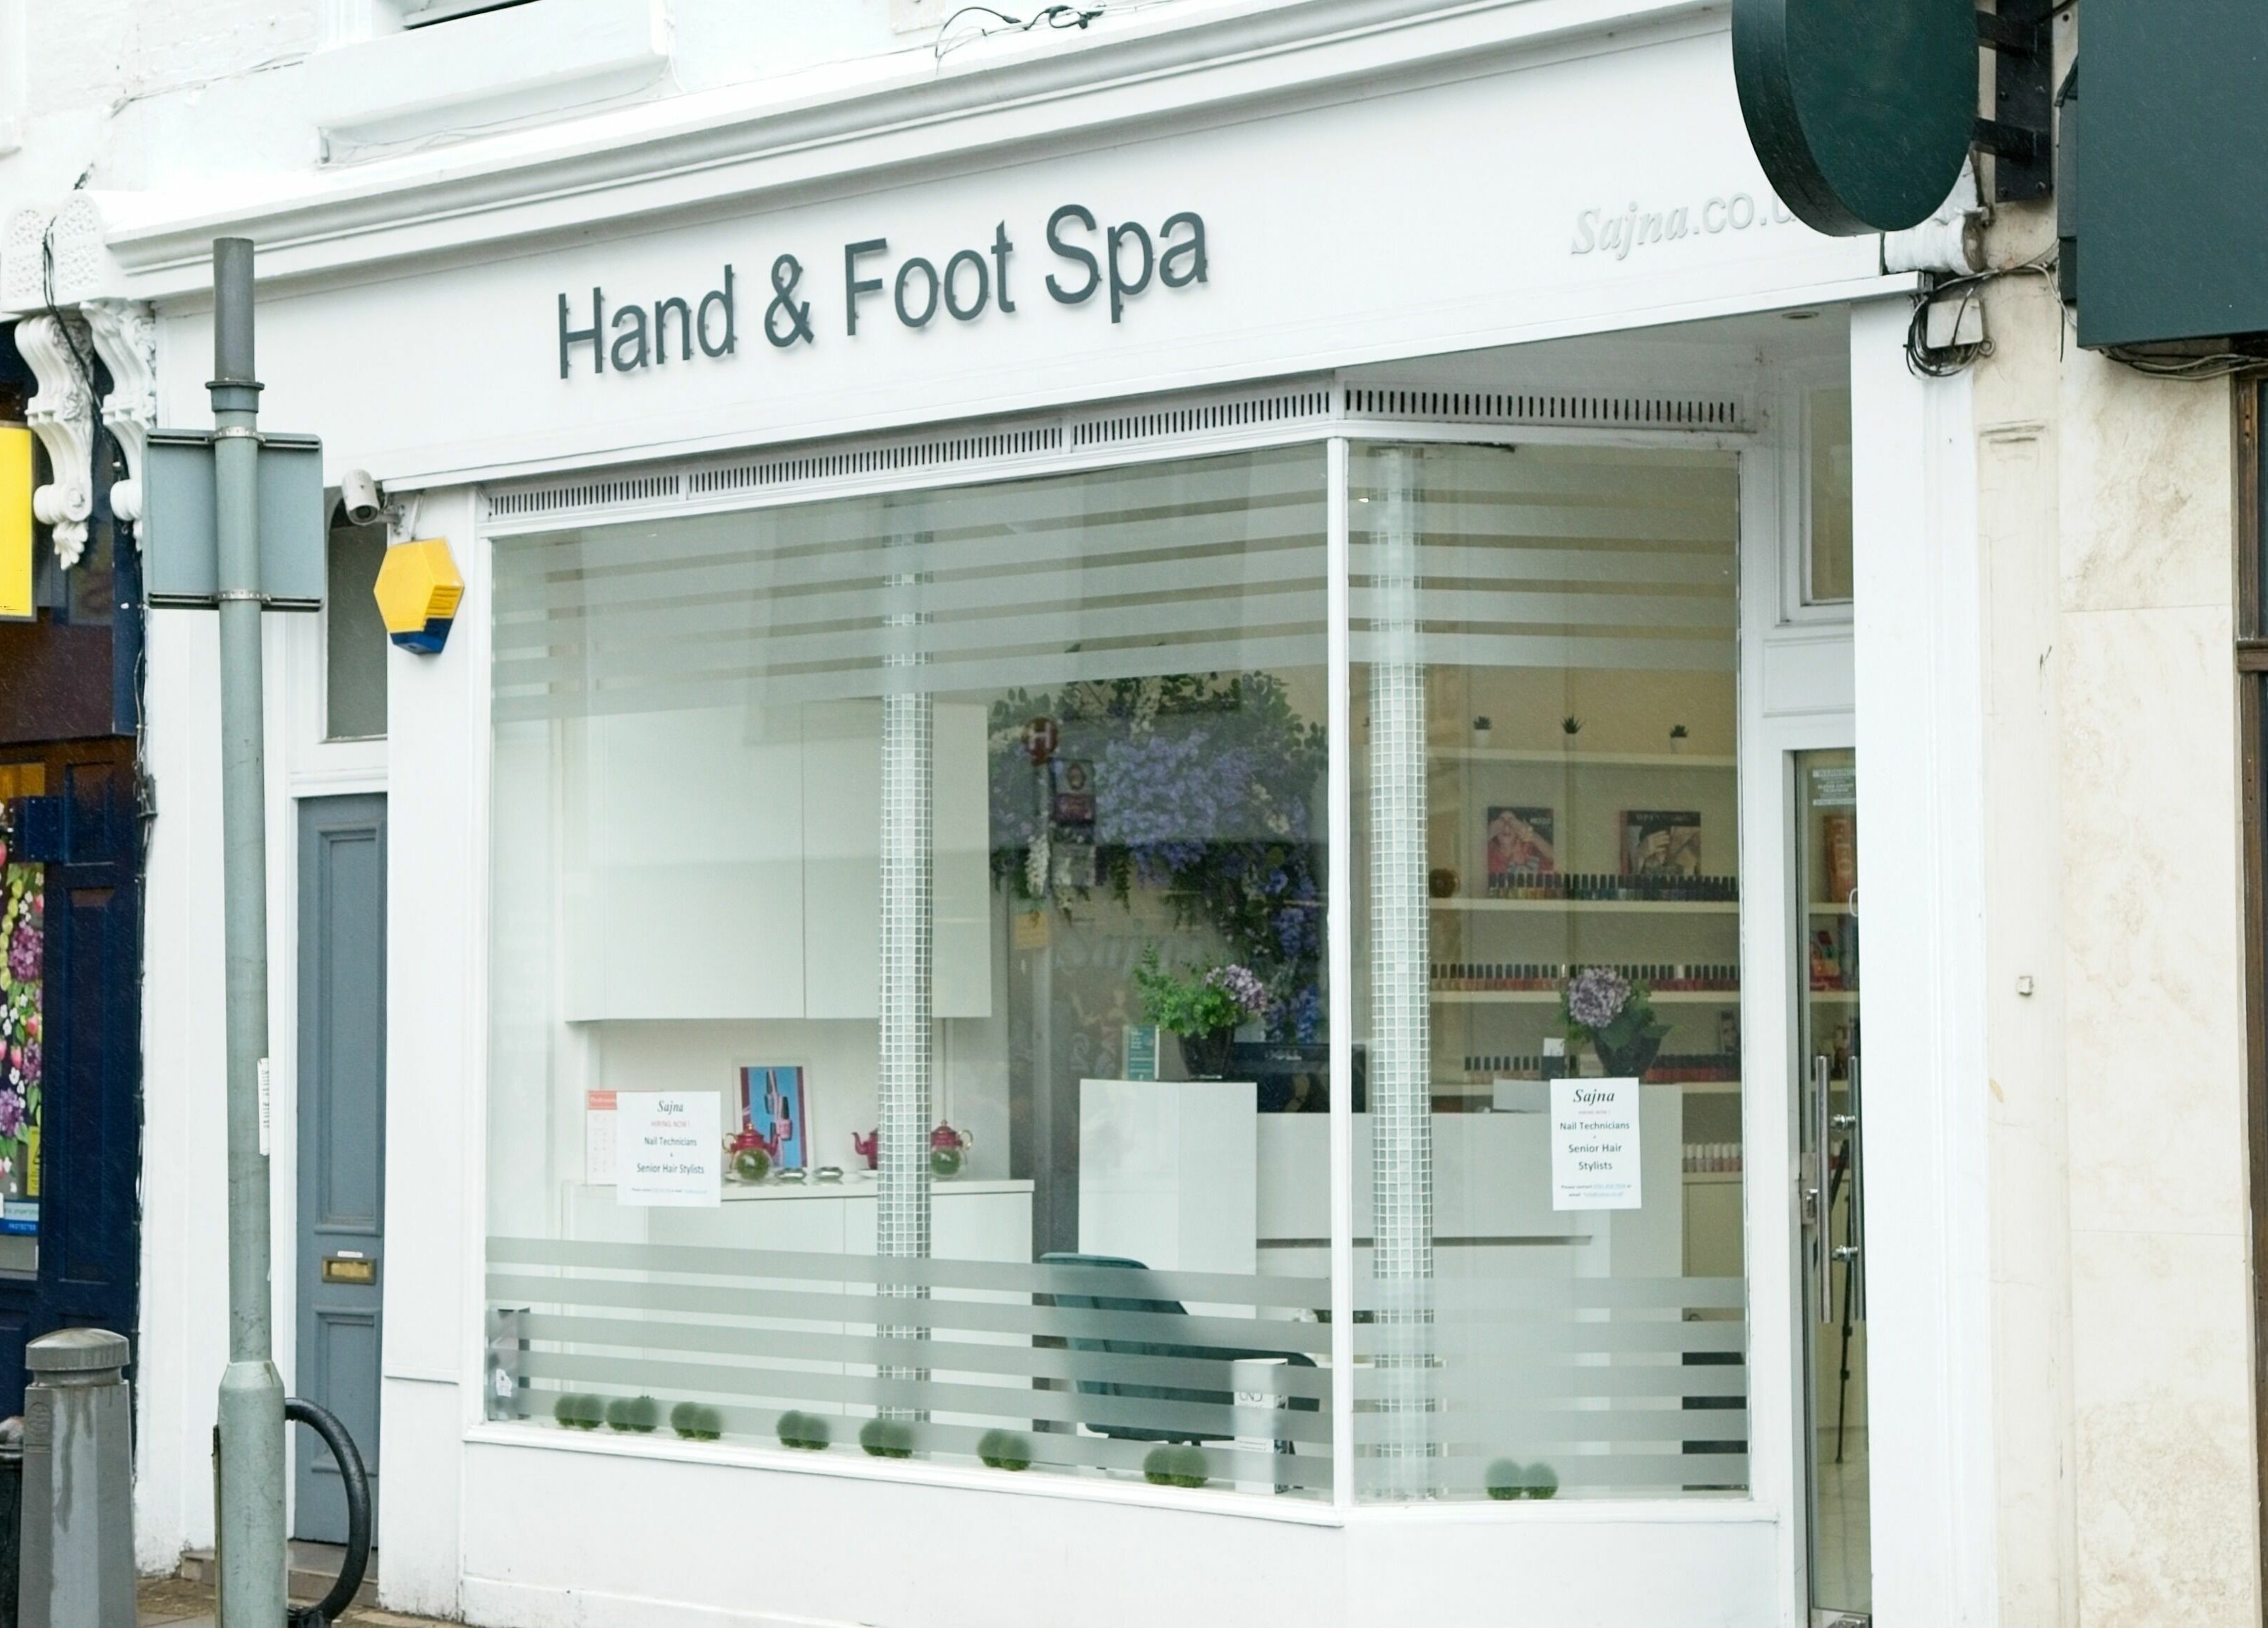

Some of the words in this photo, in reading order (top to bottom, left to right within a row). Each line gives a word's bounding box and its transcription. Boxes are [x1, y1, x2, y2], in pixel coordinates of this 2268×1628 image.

[558, 264, 736, 380] Hand
[764, 253, 815, 348] &
[844, 220, 1016, 337] Foot
[1044, 203, 1209, 324] Spa
[1573, 1089, 1615, 1105] Sajna
[657, 1100, 683, 1115] Sajna
[1579, 1121, 1630, 1130] Technicians
[644, 1137, 657, 1146] Nail
[659, 1137, 697, 1147] Technicians
[1568, 1144, 1599, 1154] Senior
[1602, 1144, 1622, 1153] Hair
[637, 1163, 661, 1173] Senior
[662, 1163, 678, 1173] Hair
[679, 1164, 704, 1175] Stylists
[1578, 1161, 1613, 1172] Stylists
